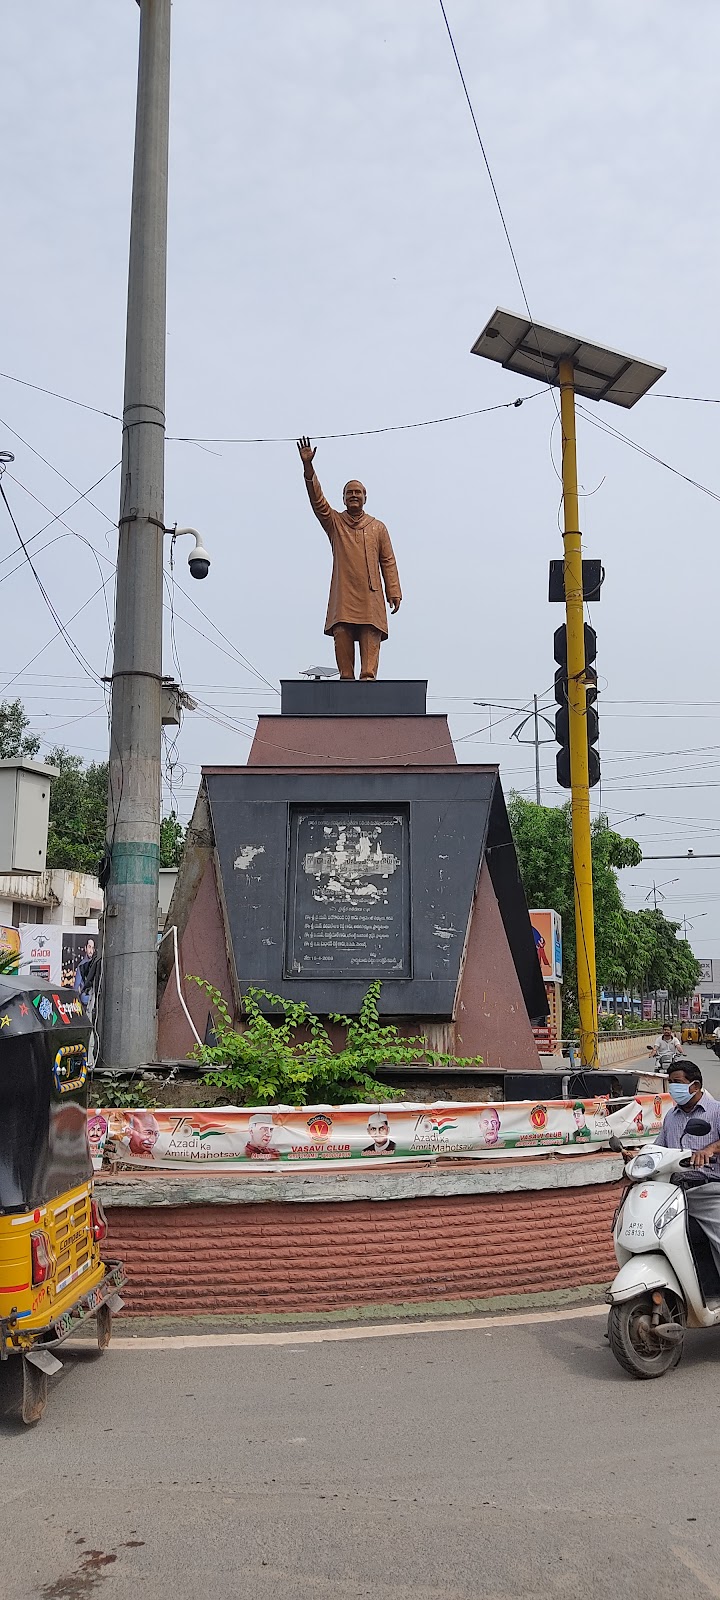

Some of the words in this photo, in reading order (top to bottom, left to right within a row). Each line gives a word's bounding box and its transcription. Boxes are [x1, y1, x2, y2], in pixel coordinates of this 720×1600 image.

[413, 1133, 438, 1143] Azadi
[544, 1131, 562, 1139] CLUB
[168, 1139, 198, 1148] Azadi
[200, 1142, 211, 1150] Ka
[291, 1145, 324, 1153] VASAVI
[326, 1144, 350, 1152] CLUB
[410, 1143, 431, 1151] Amrit
[431, 1143, 473, 1152] Mahotsav
[164, 1149, 189, 1157] Amrit
[190, 1151, 241, 1159] Mahotsav
